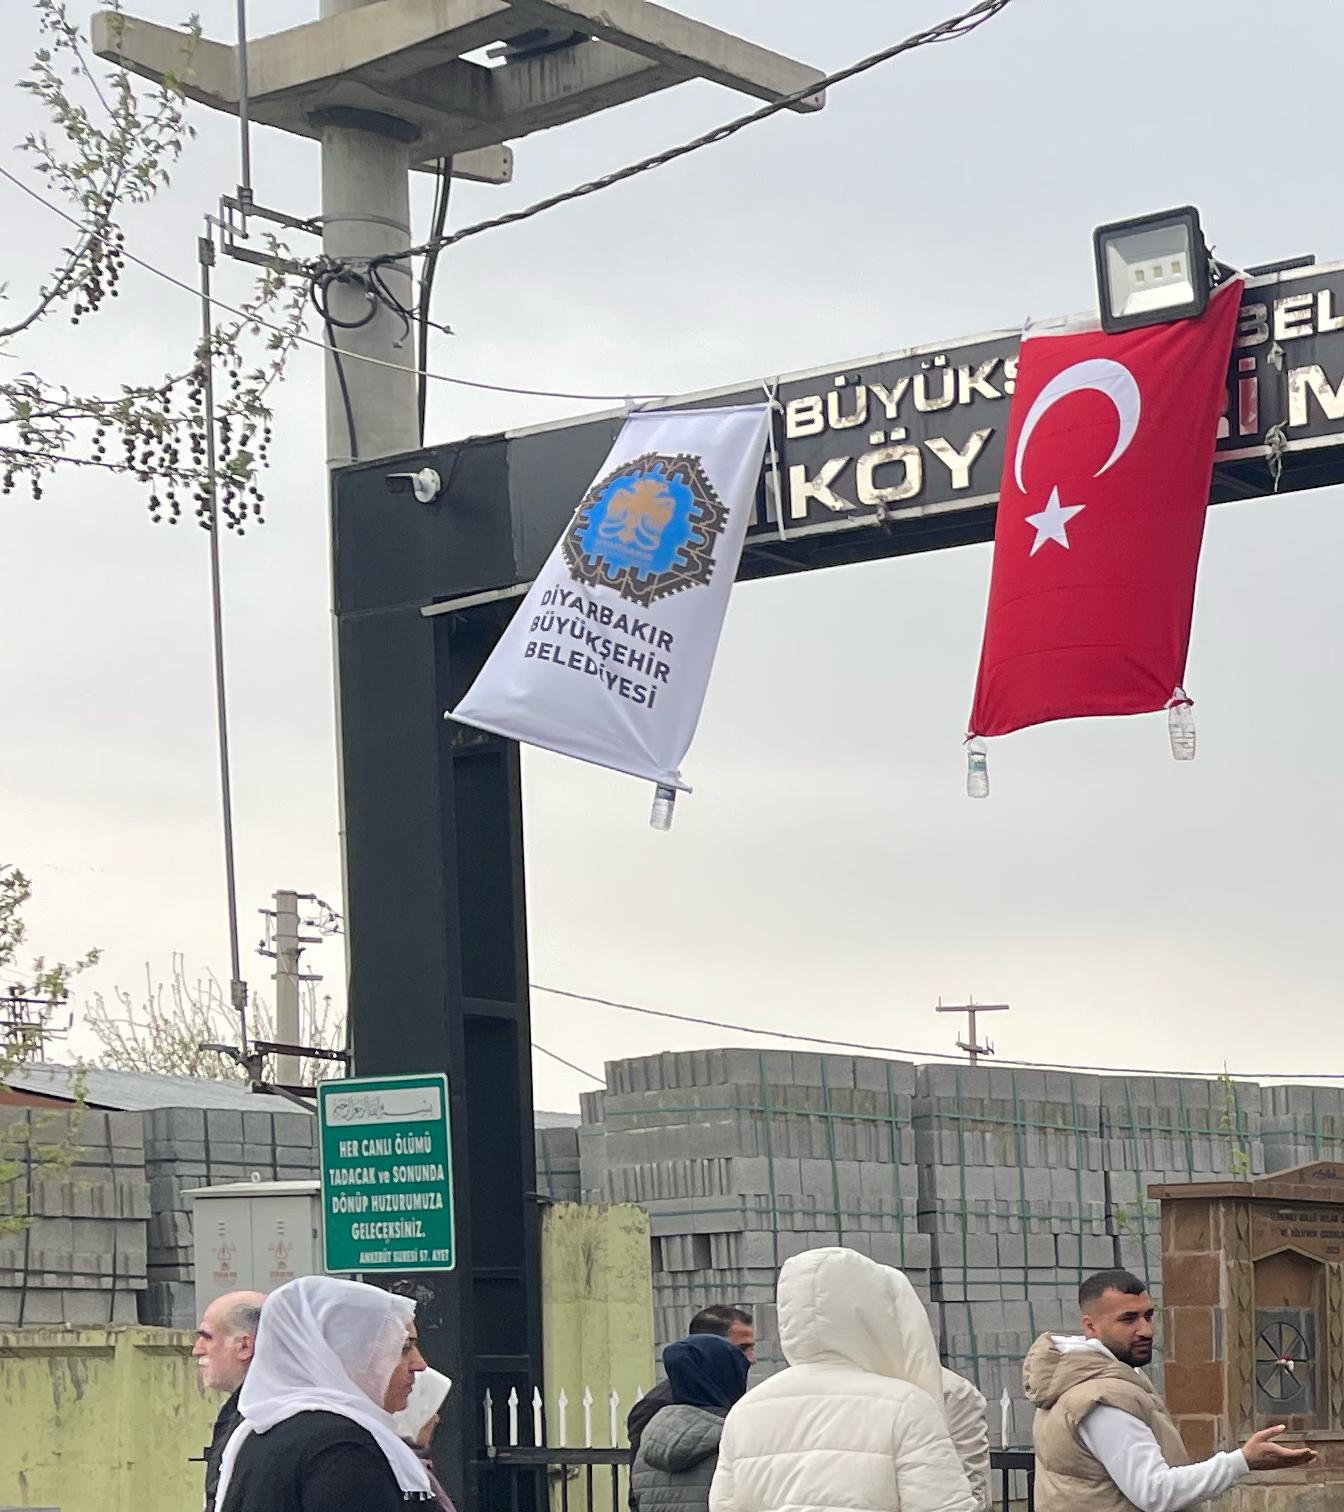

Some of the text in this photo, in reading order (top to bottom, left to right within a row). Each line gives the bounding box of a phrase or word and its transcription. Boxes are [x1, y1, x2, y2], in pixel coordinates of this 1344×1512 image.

[540, 584, 675, 652] DİYARBAKIR
[529, 610, 671, 684] BÜYÜKŞEHİR
[523, 640, 658, 709] BELEDİYESİ
[339, 1131, 431, 1158] HER CANLI ÖLÜMÜ
[393, 1164, 444, 1183] SONUNDA
[332, 1192, 368, 1213] DÖNÜP
